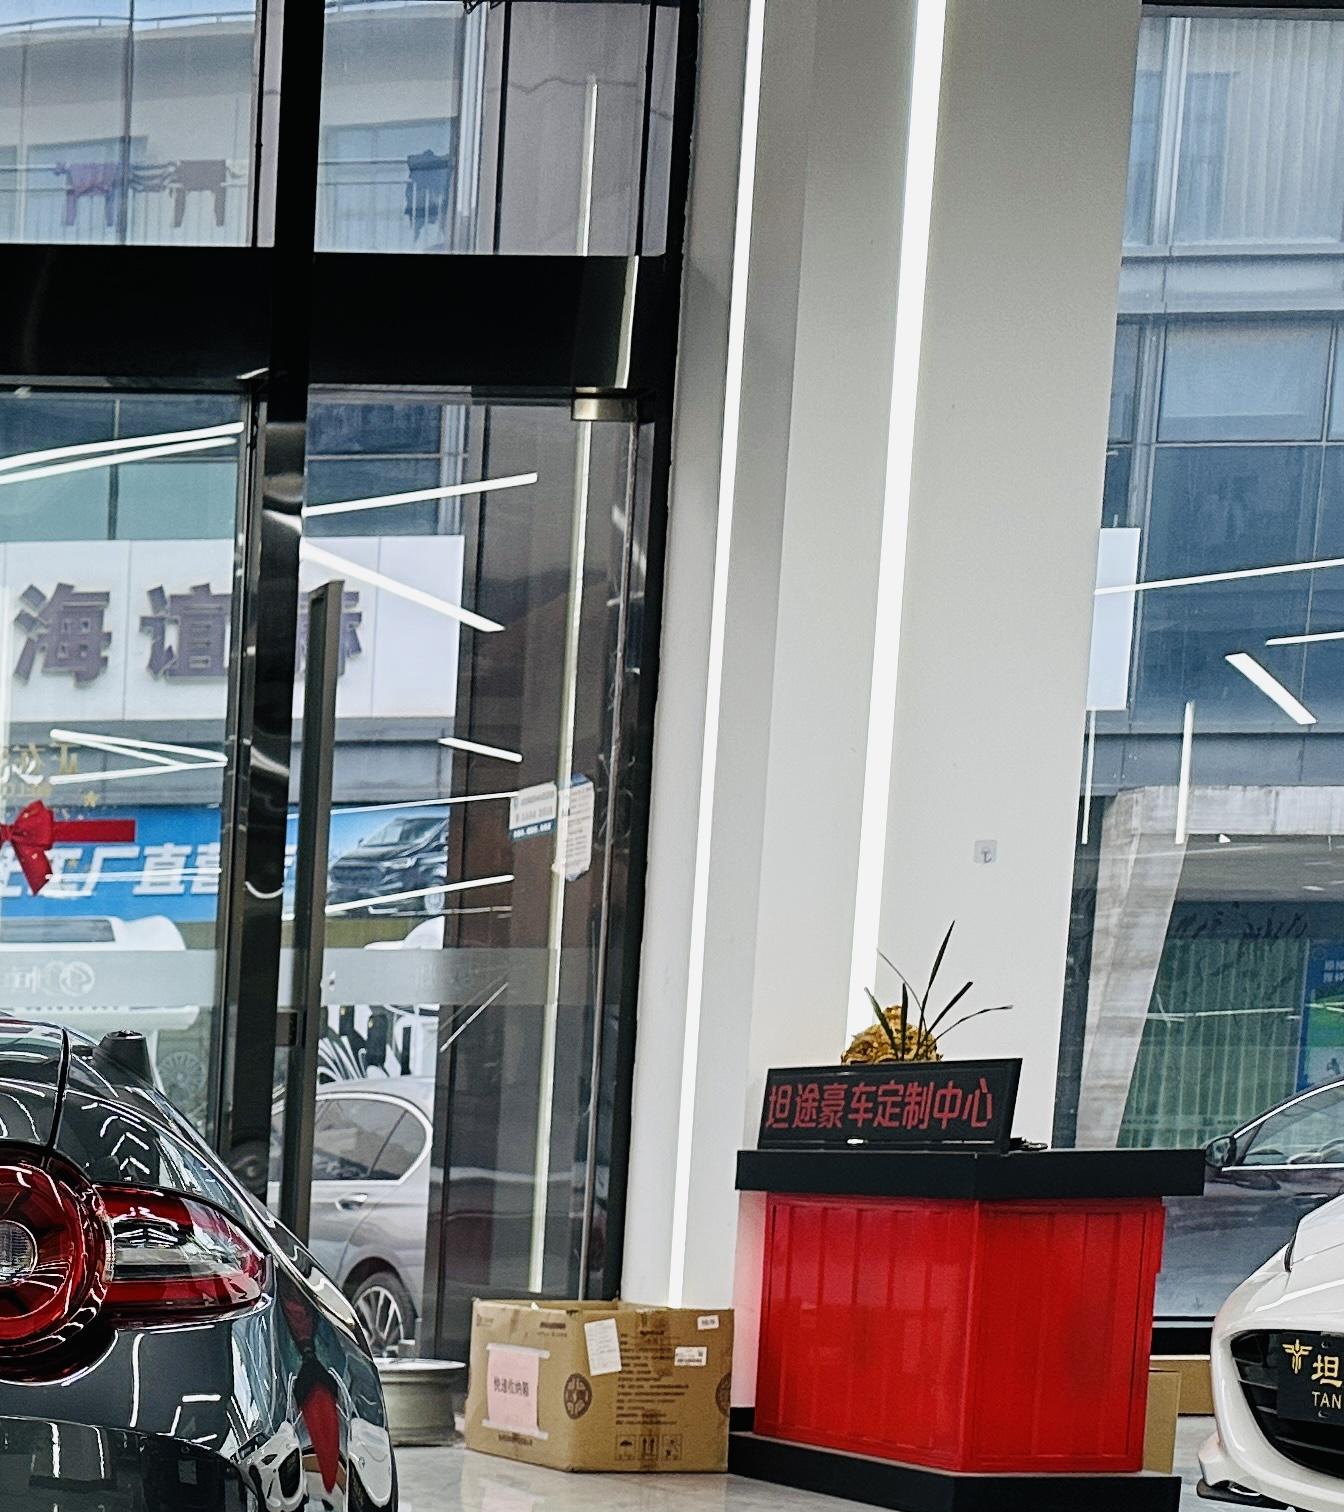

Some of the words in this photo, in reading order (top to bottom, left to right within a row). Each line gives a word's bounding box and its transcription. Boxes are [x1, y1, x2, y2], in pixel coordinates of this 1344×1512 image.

[766, 1077, 993, 1130] 坦途豪车定制中心
[1311, 1354, 1343, 1388] 坦
